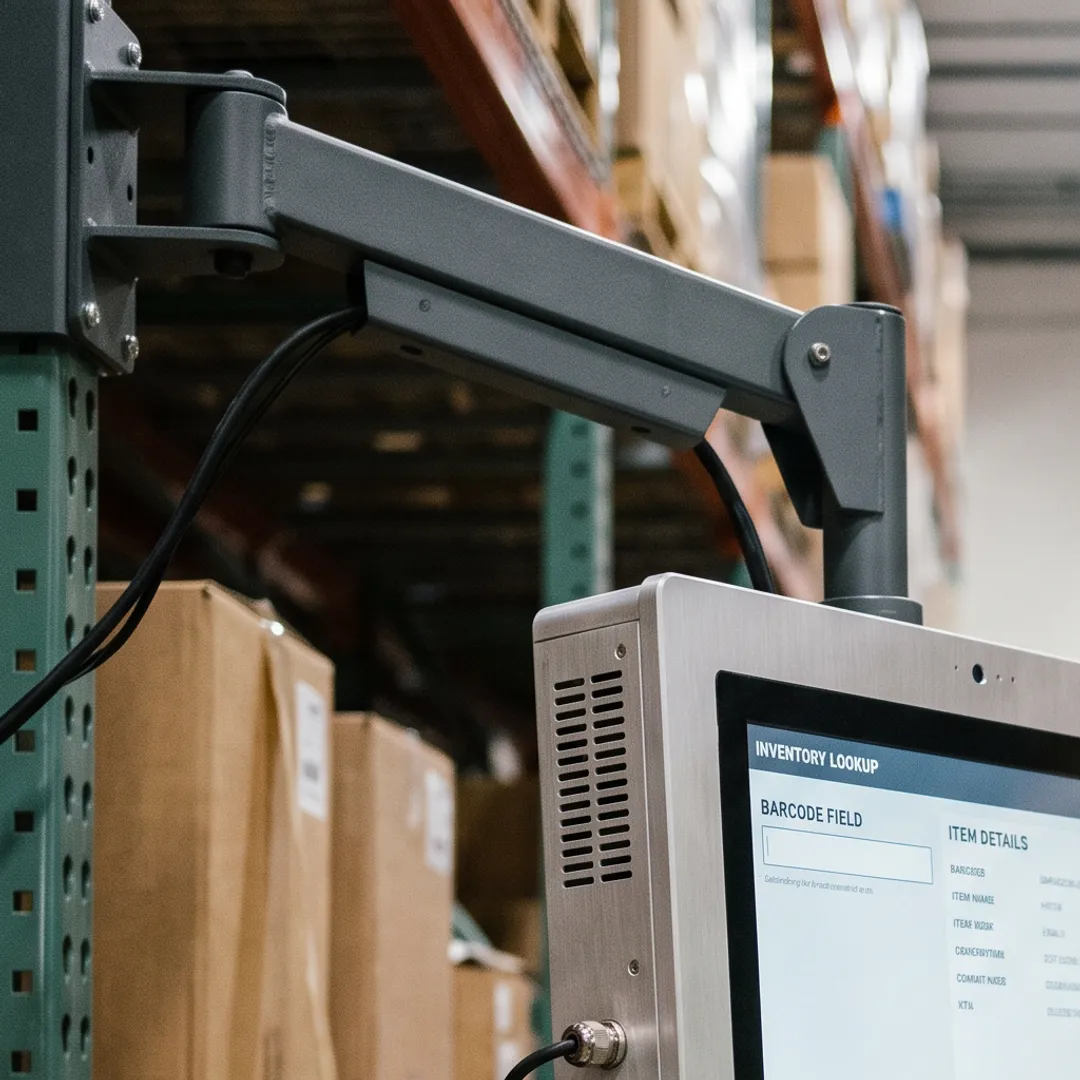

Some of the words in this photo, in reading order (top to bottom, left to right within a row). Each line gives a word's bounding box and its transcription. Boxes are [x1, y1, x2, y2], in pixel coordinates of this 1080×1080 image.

[756, 741, 826, 766] INVENTORY
[829, 752, 879, 774] LOOKUP
[761, 799, 824, 823] BARCODE
[827, 808, 863, 828] FIELD
[949, 825, 977, 844] ITEM
[981, 831, 1029, 851] DETAILS
